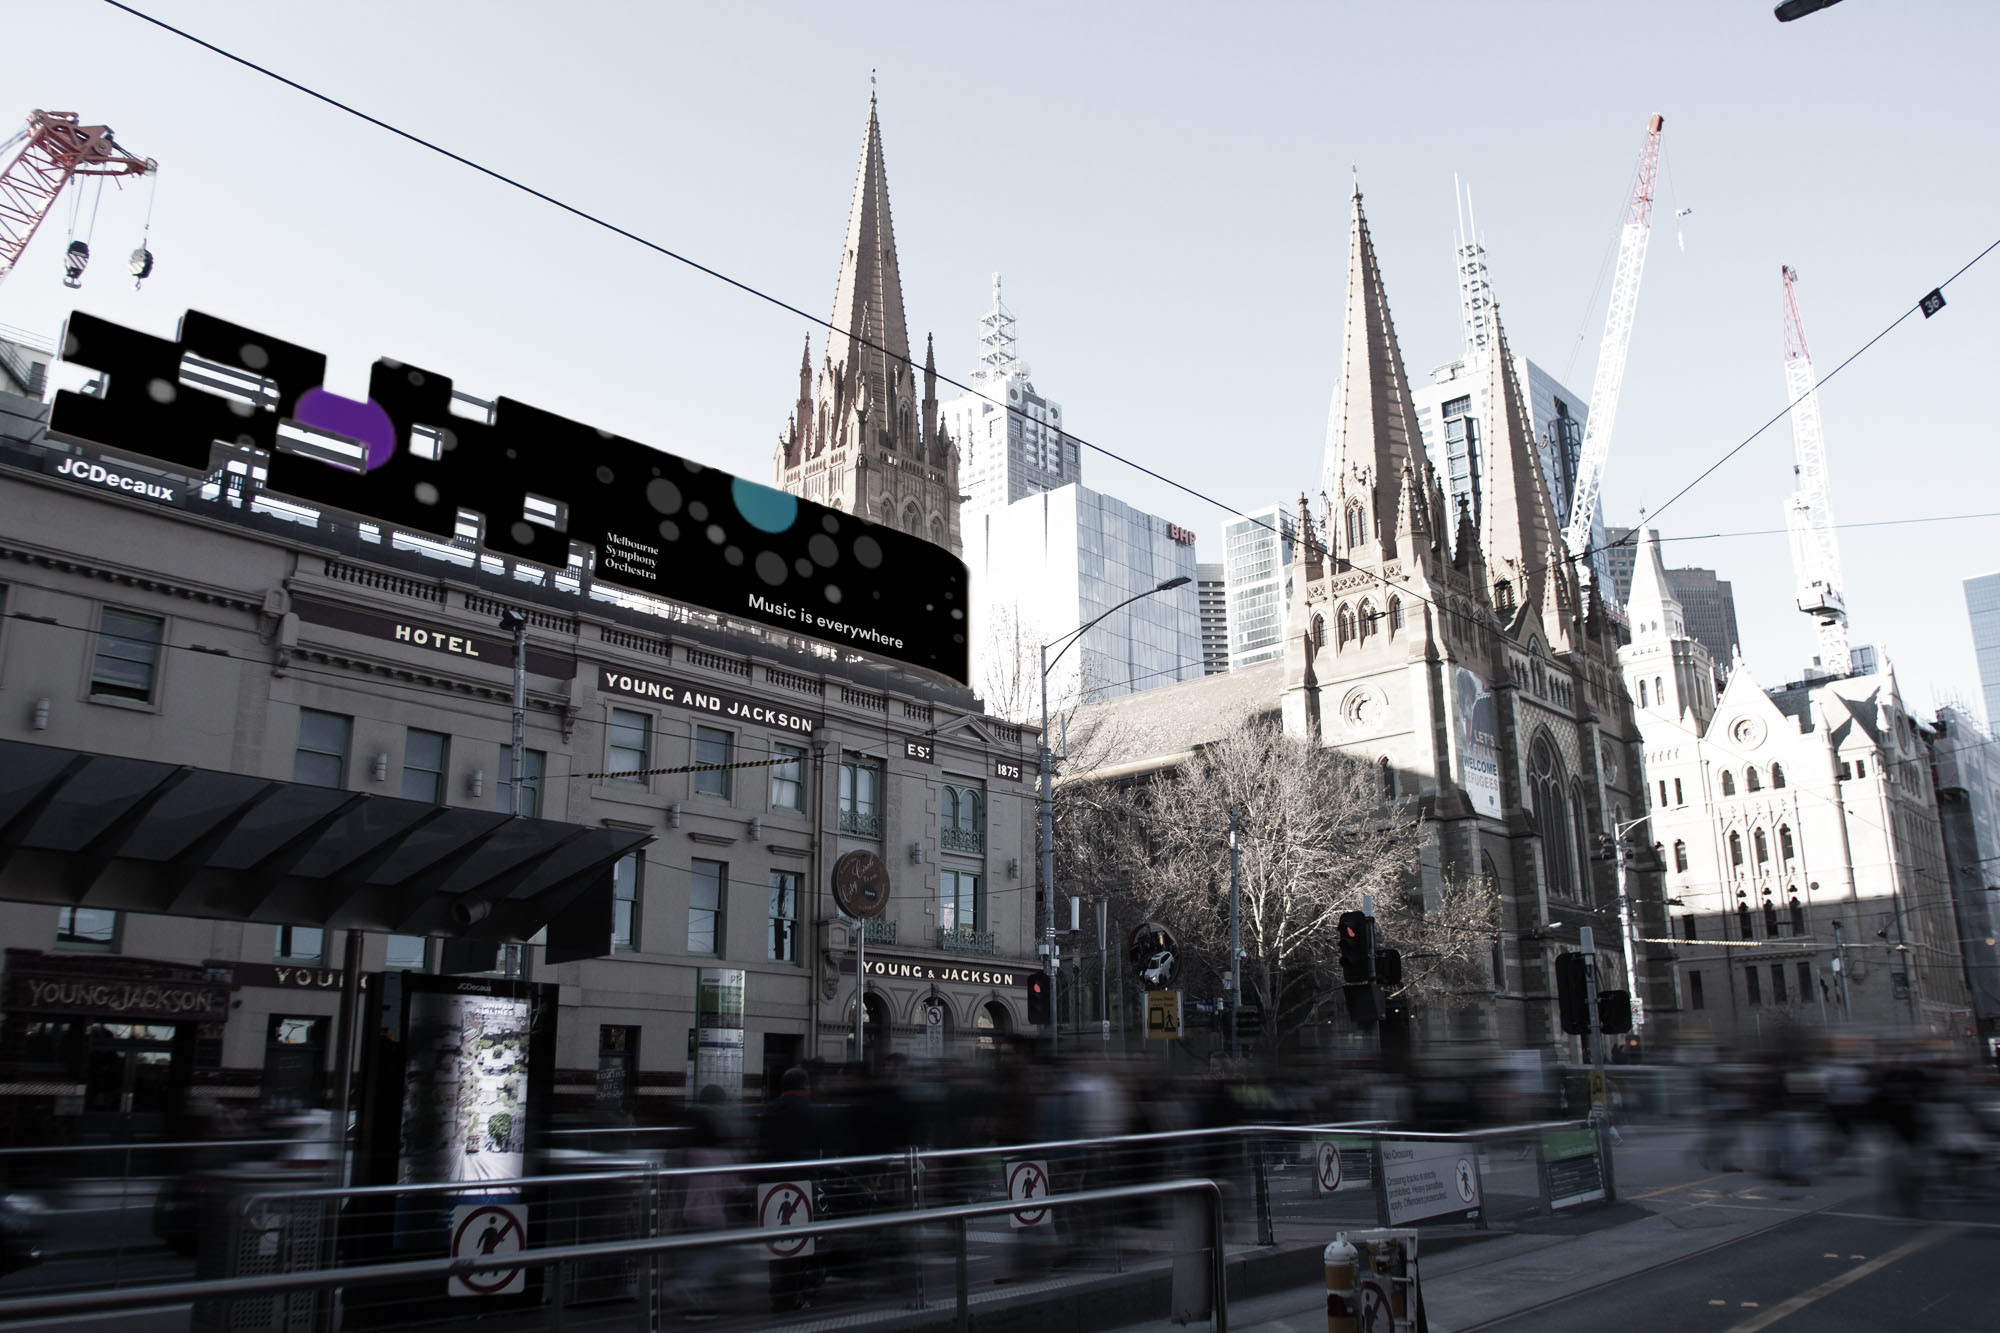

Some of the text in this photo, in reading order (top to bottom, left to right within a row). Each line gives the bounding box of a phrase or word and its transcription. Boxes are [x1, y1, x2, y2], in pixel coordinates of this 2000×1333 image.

[1924, 296, 1940, 313] 36
[57, 458, 174, 501] JCDecaux
[607, 532, 659, 555] Melbourne
[1166, 522, 1196, 546] BHP
[605, 544, 658, 569] Symphony
[605, 558, 657, 580] Orchestra
[748, 593, 904, 649] Music is everywhere
[395, 624, 479, 657] HOTEL
[606, 672, 813, 733] YOUNG AND JACKSON
[997, 763, 1020, 779] 1875
[1464, 756, 1498, 777] WELCOME
[863, 961, 1014, 985] YOUNG & JACKSON
[28, 979, 109, 1007] YOUNG
